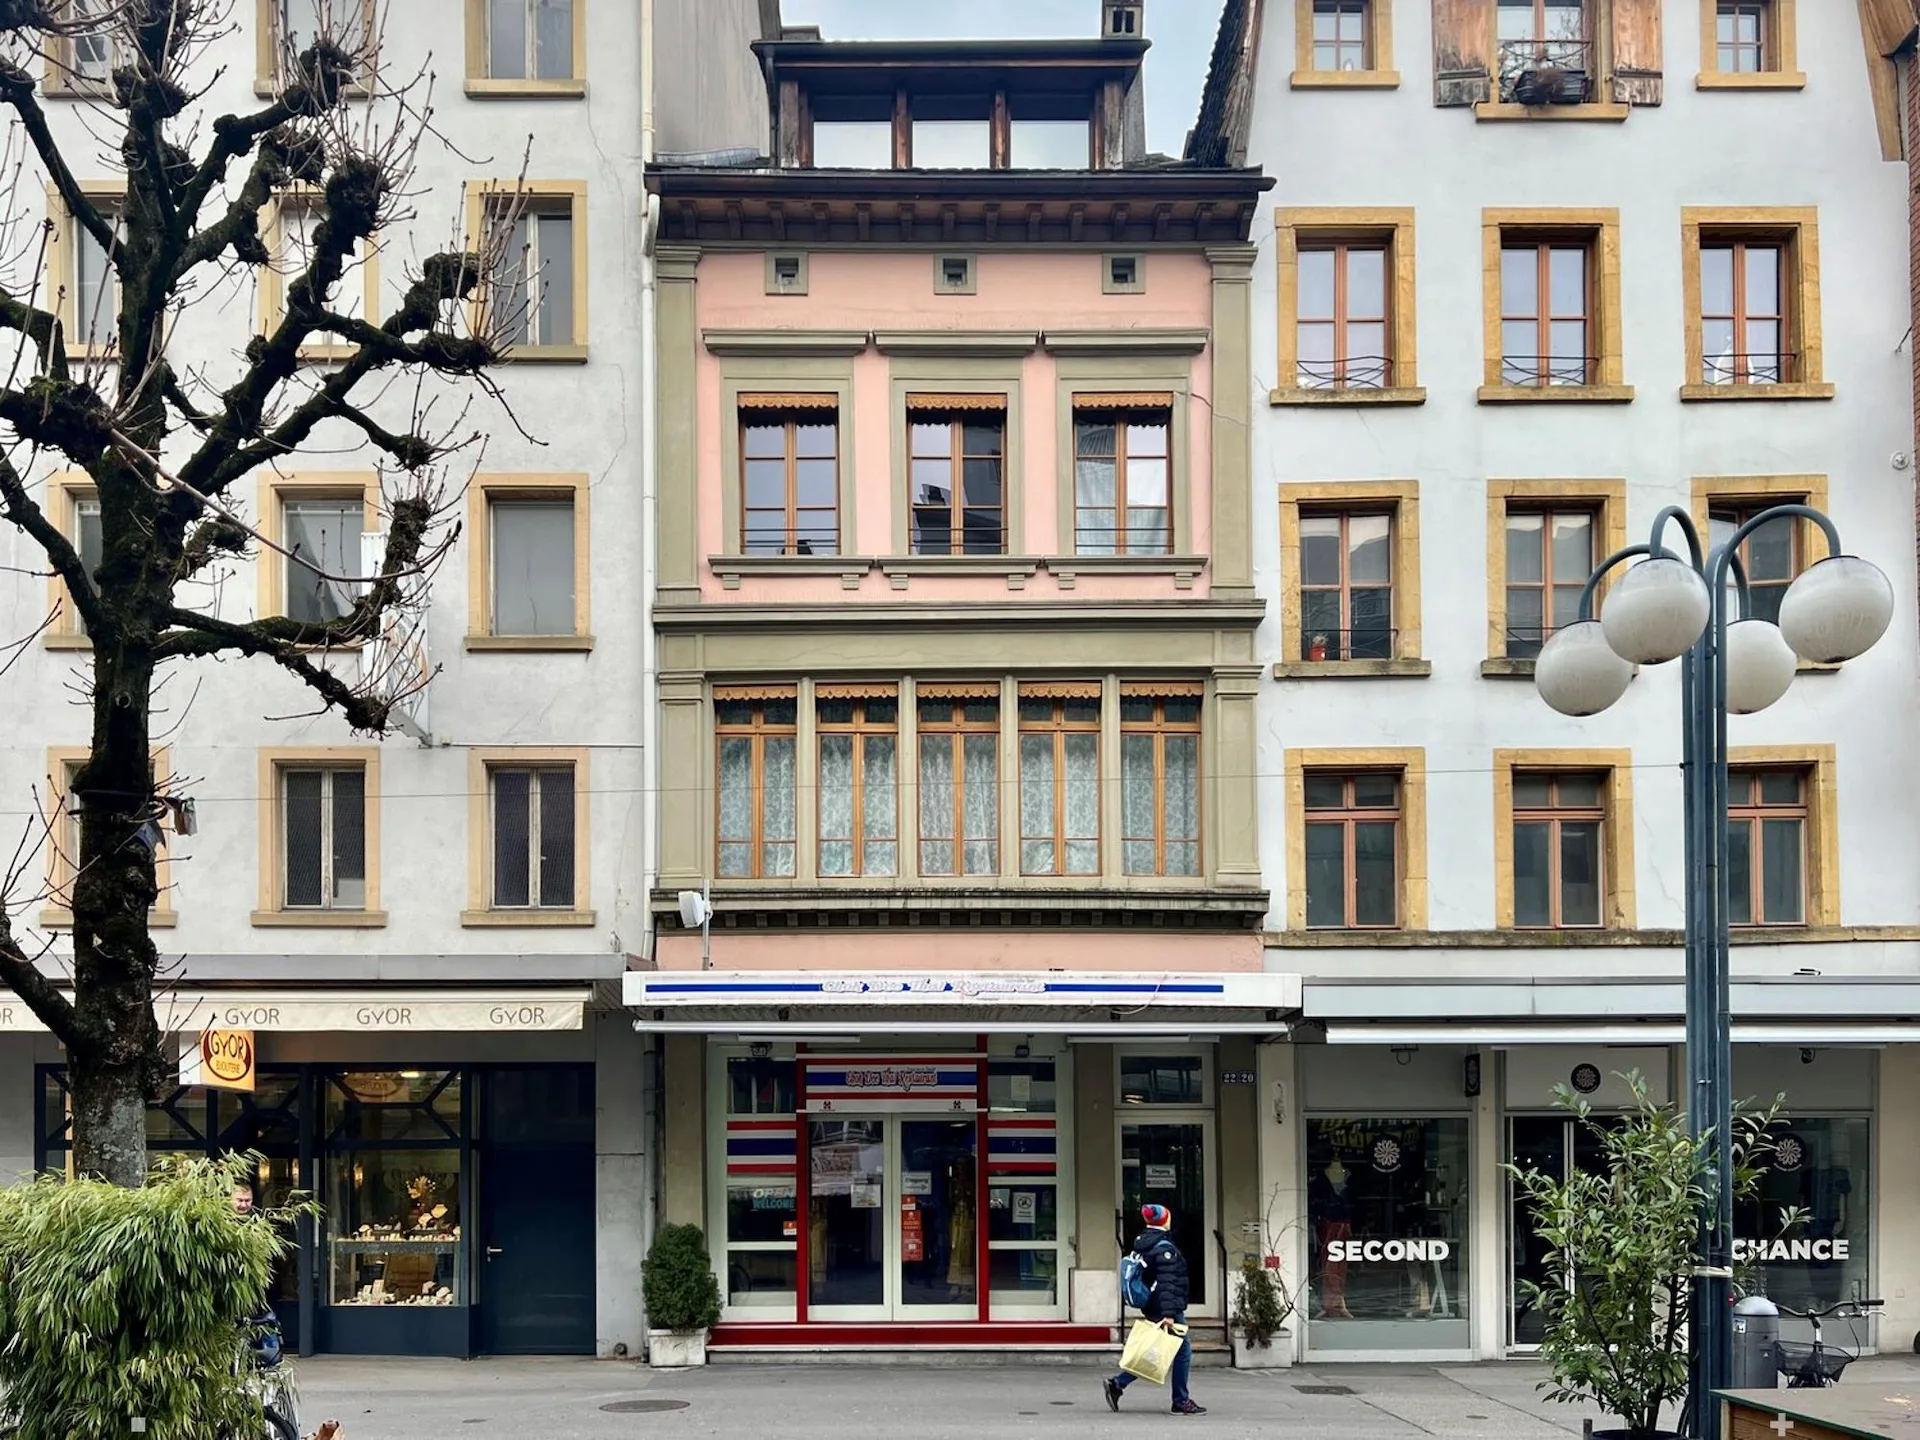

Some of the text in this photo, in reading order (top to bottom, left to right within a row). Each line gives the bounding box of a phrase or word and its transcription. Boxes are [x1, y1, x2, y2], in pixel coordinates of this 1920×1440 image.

[225, 1008, 280, 1025] GYOR
[356, 1007, 412, 1025] GYOR
[489, 1007, 545, 1024] GYOR
[210, 1030, 244, 1060] GYOR
[1223, 1073, 1254, 1083] 22 20
[753, 1187, 795, 1199] OPEN
[752, 1198, 796, 1209] WELCOME
[1327, 1240, 1450, 1262] SECOND
[1731, 1239, 1849, 1261] CHANCE
